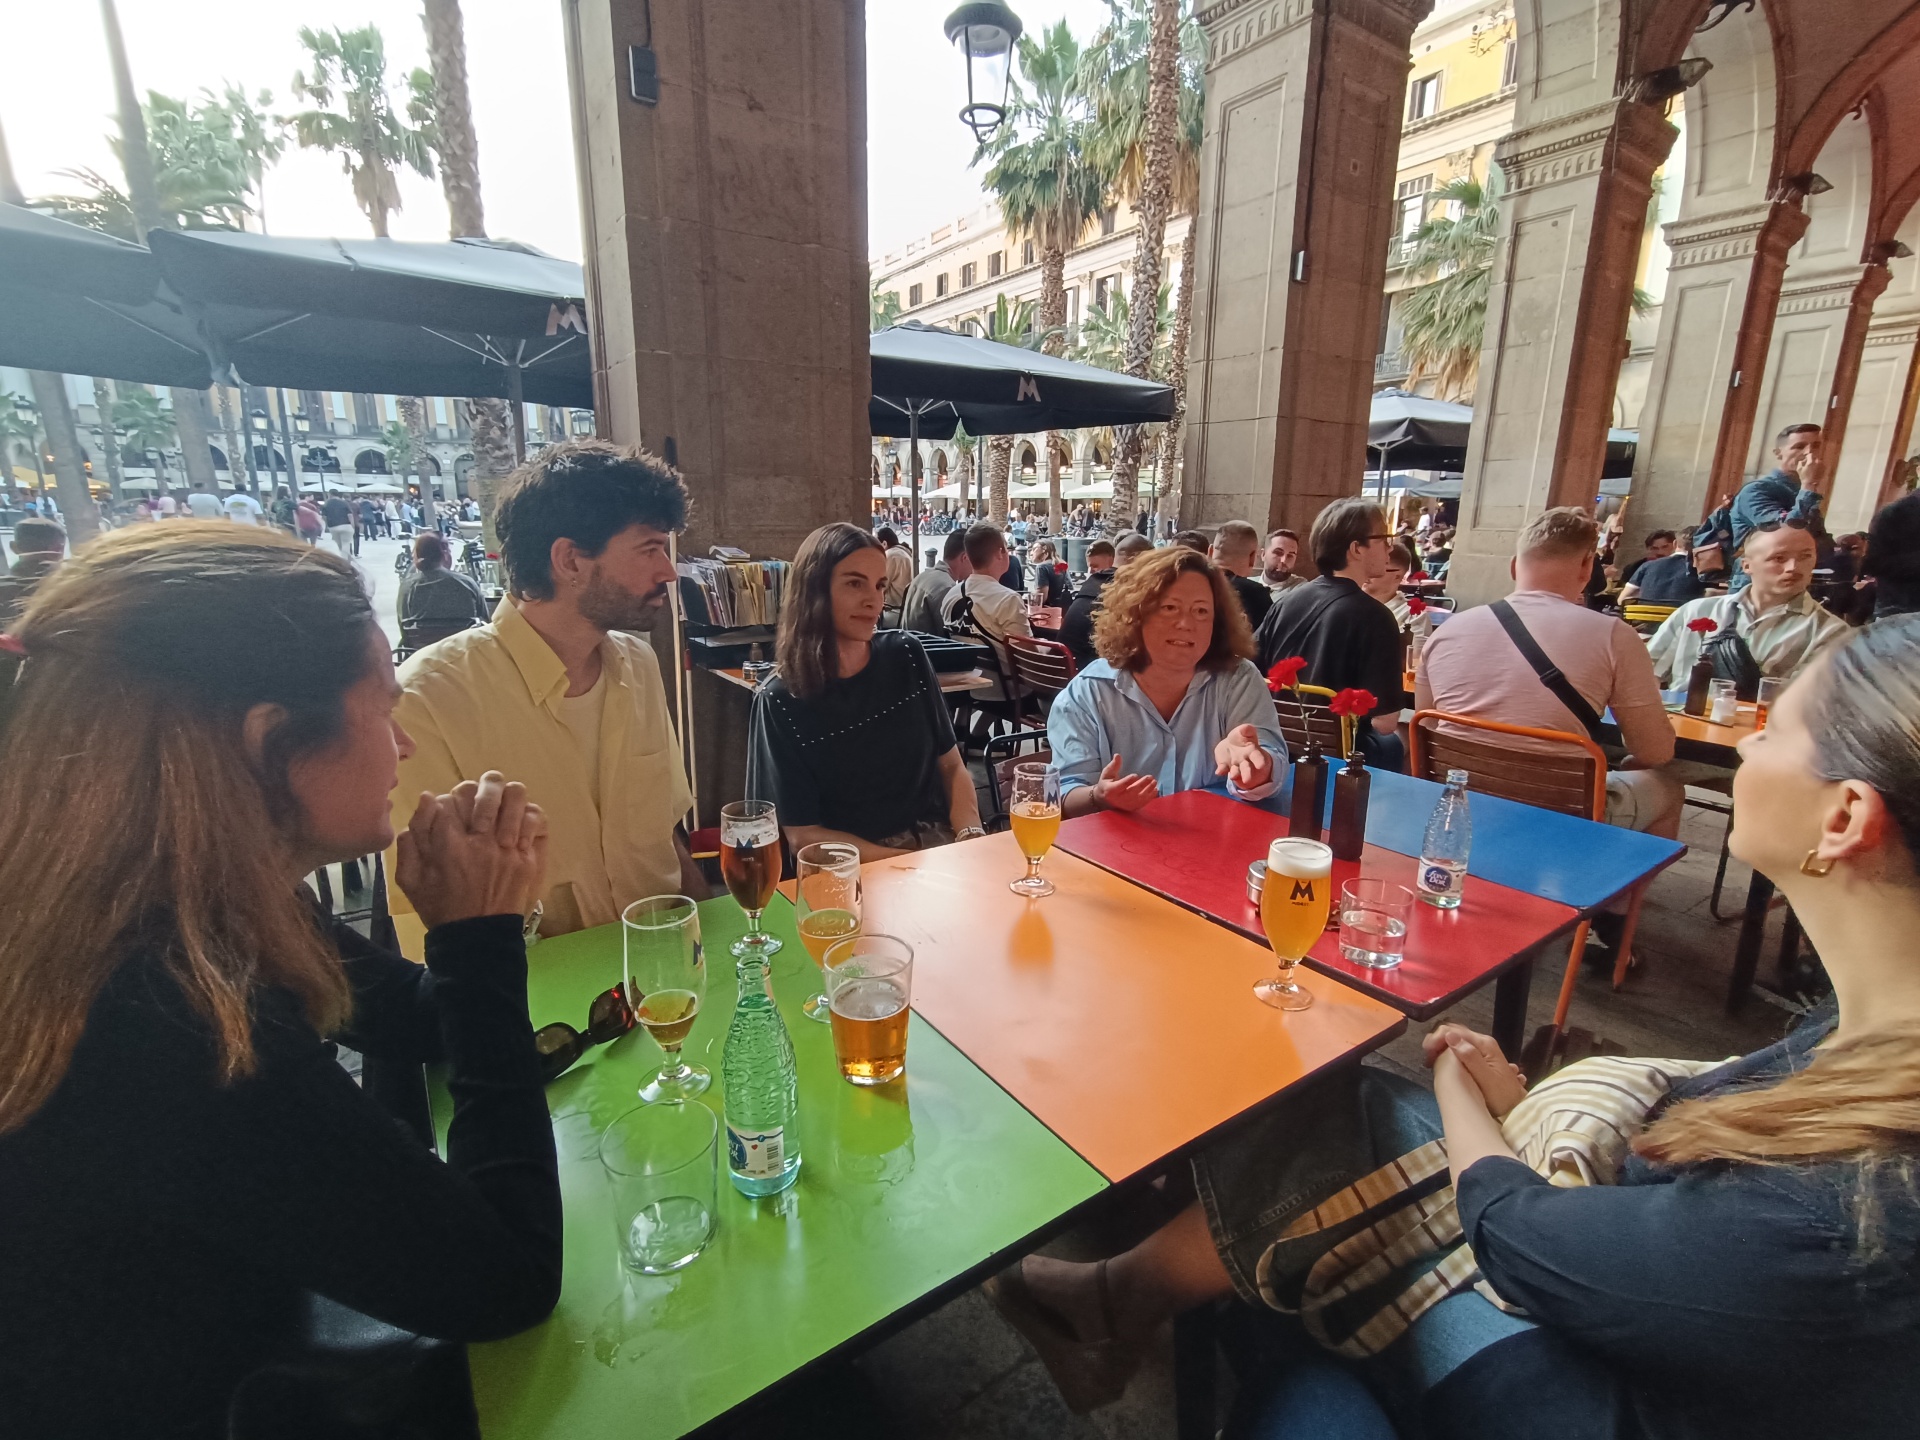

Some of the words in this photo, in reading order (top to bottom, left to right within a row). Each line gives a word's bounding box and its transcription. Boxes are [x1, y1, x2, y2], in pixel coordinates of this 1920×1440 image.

[545, 302, 588, 336] M
[1017, 375, 1042, 402] M
[1290, 880, 1315, 901] M
